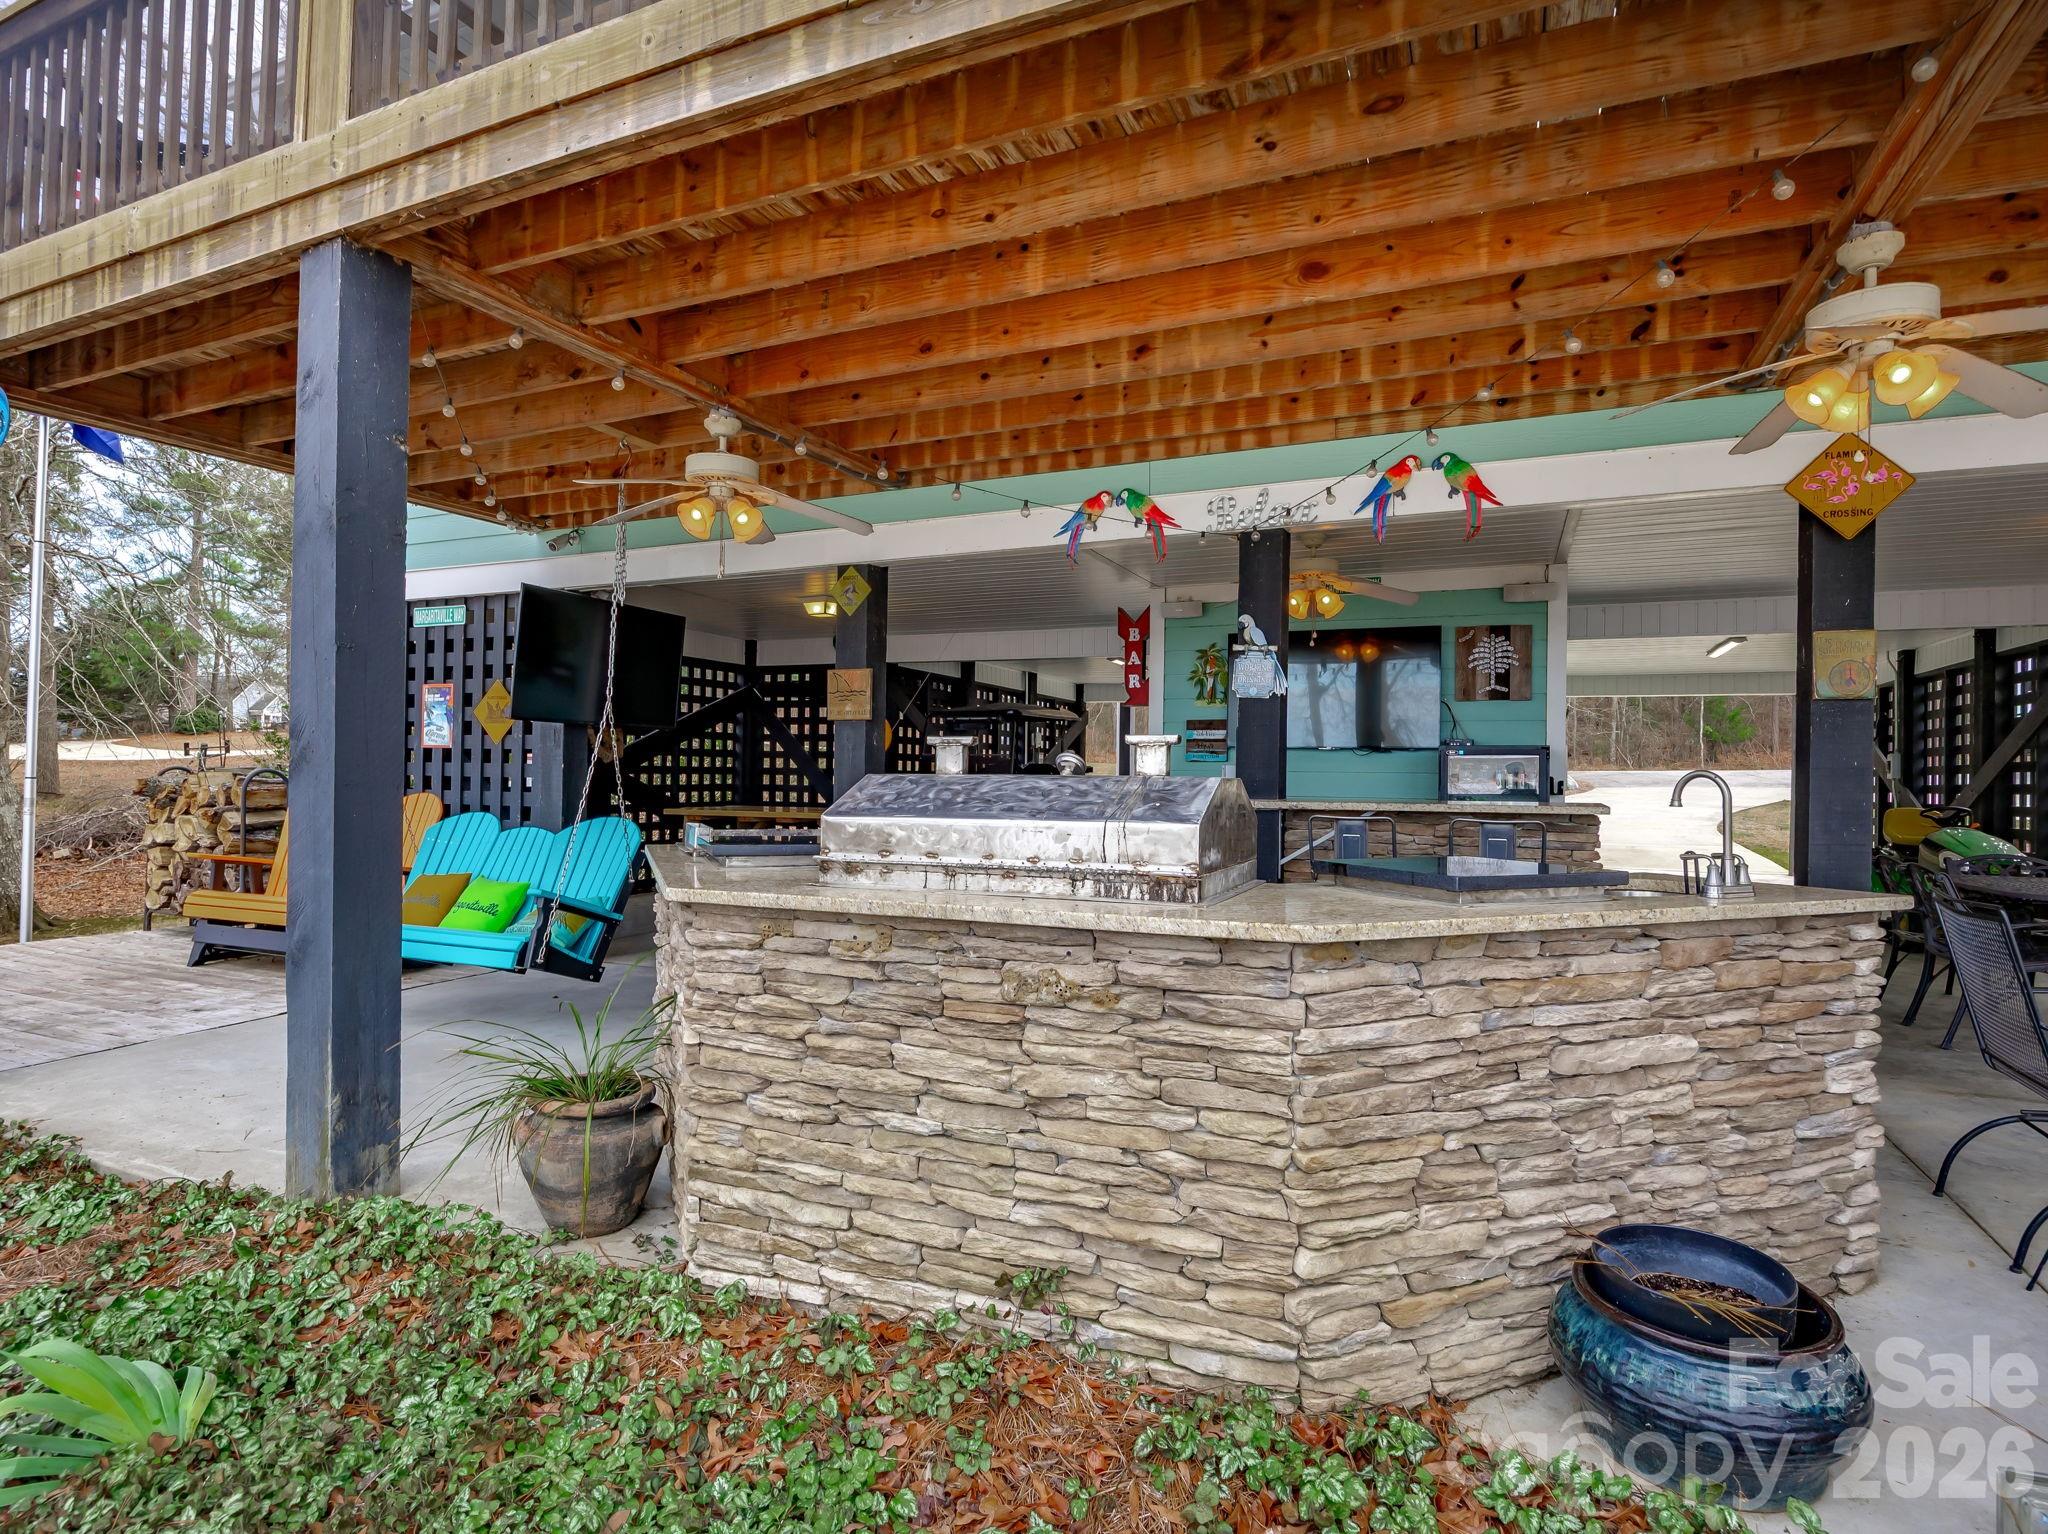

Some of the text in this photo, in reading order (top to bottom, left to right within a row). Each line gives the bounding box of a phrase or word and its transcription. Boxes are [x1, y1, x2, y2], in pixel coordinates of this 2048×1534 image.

[1825, 449, 1873, 460] FLAMIGO
[1206, 488, 1319, 533] Relax
[1823, 508, 1874, 519] CROSSING
[1128, 627, 1141, 688] BAR
